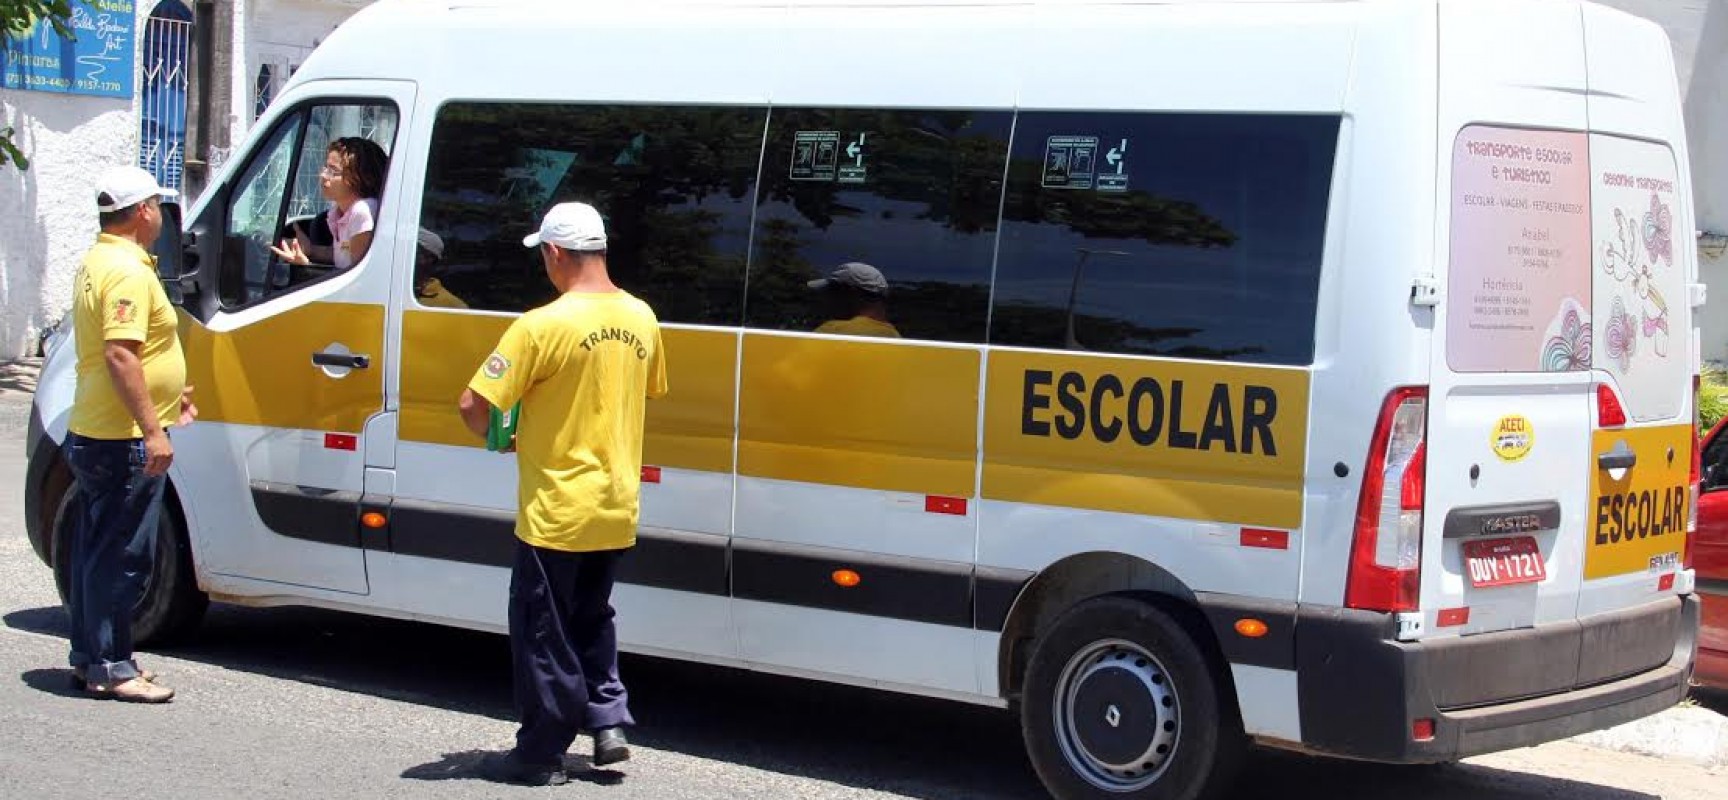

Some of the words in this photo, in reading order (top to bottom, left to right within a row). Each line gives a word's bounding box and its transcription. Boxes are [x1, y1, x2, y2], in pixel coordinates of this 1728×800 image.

[1464, 194, 1495, 207] ESCOLAR
[1022, 370, 1277, 457] ESCOLAR
[1481, 515, 1540, 535] MASTER
[1595, 486, 1684, 545] ESCOLAR
